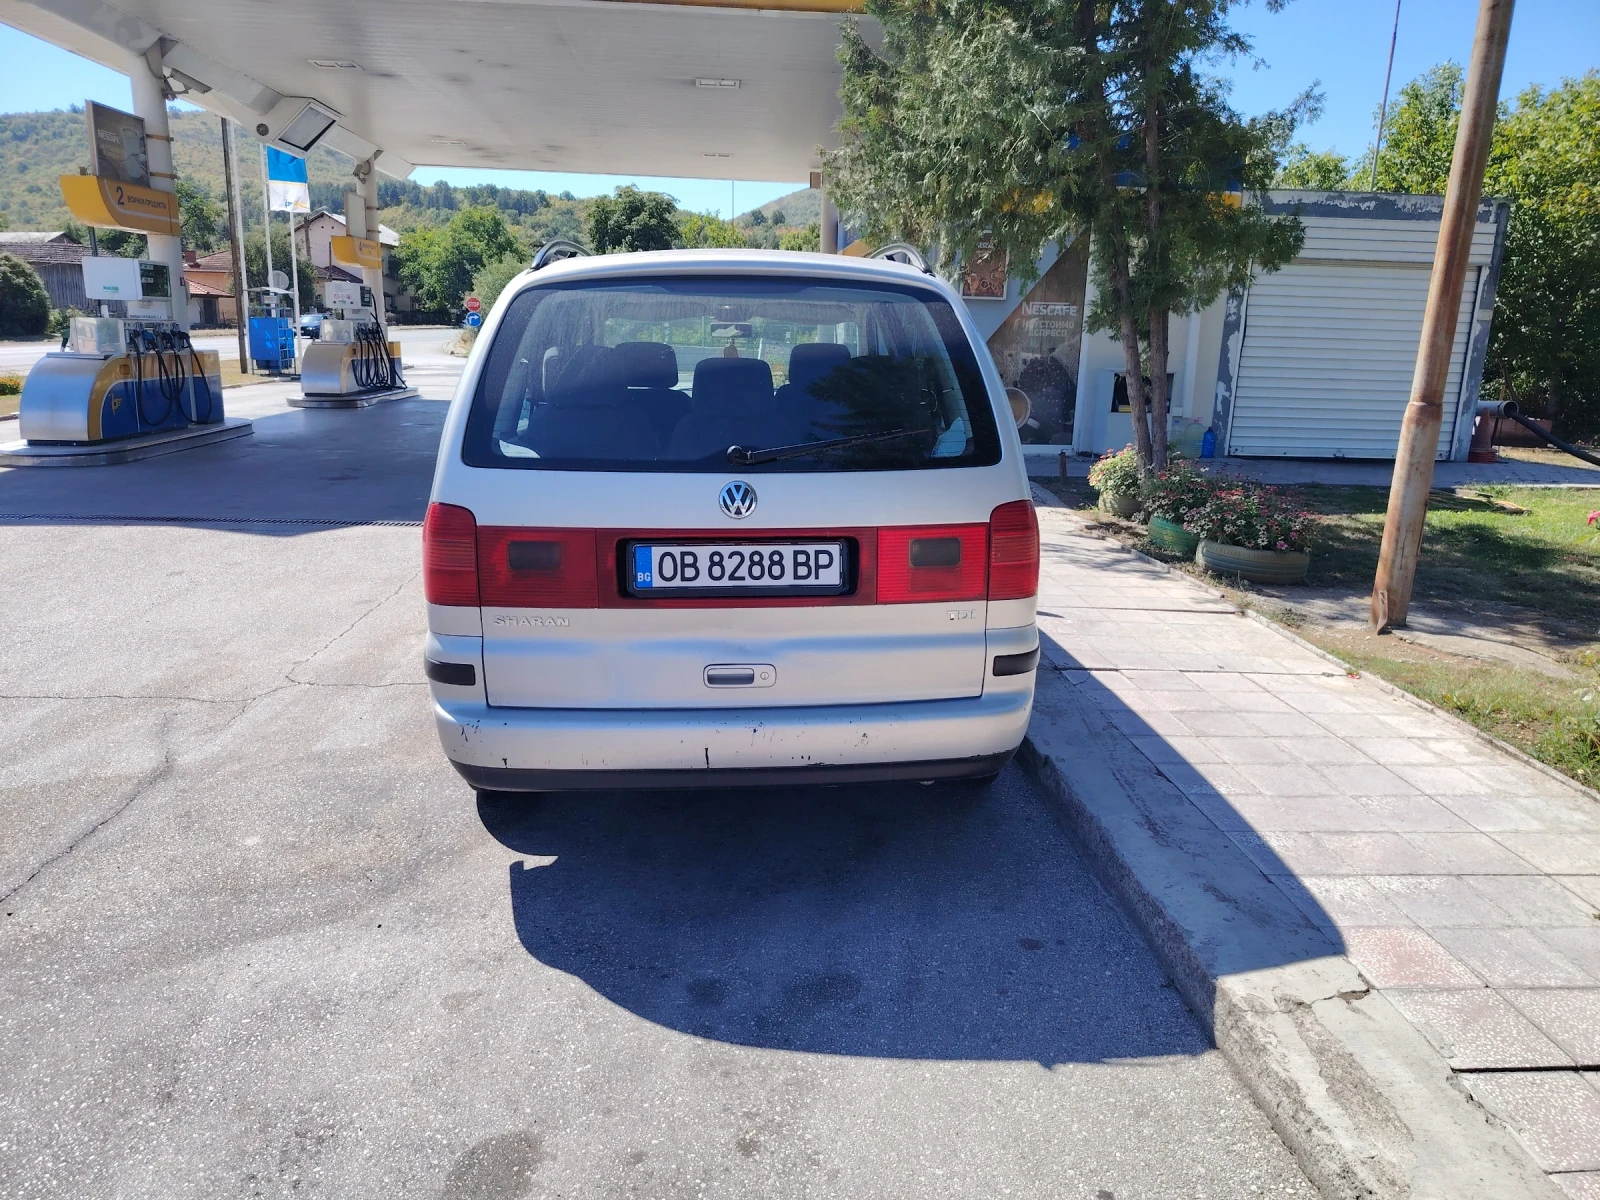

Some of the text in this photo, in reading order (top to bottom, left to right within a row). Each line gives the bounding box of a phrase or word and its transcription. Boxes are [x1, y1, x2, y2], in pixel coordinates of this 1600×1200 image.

[116, 186, 124, 205] 2
[707, 550, 786, 582] 8288
[637, 572, 651, 582] BG
[493, 614, 570, 627] SHARAN
[946, 608, 976, 620] TDI
